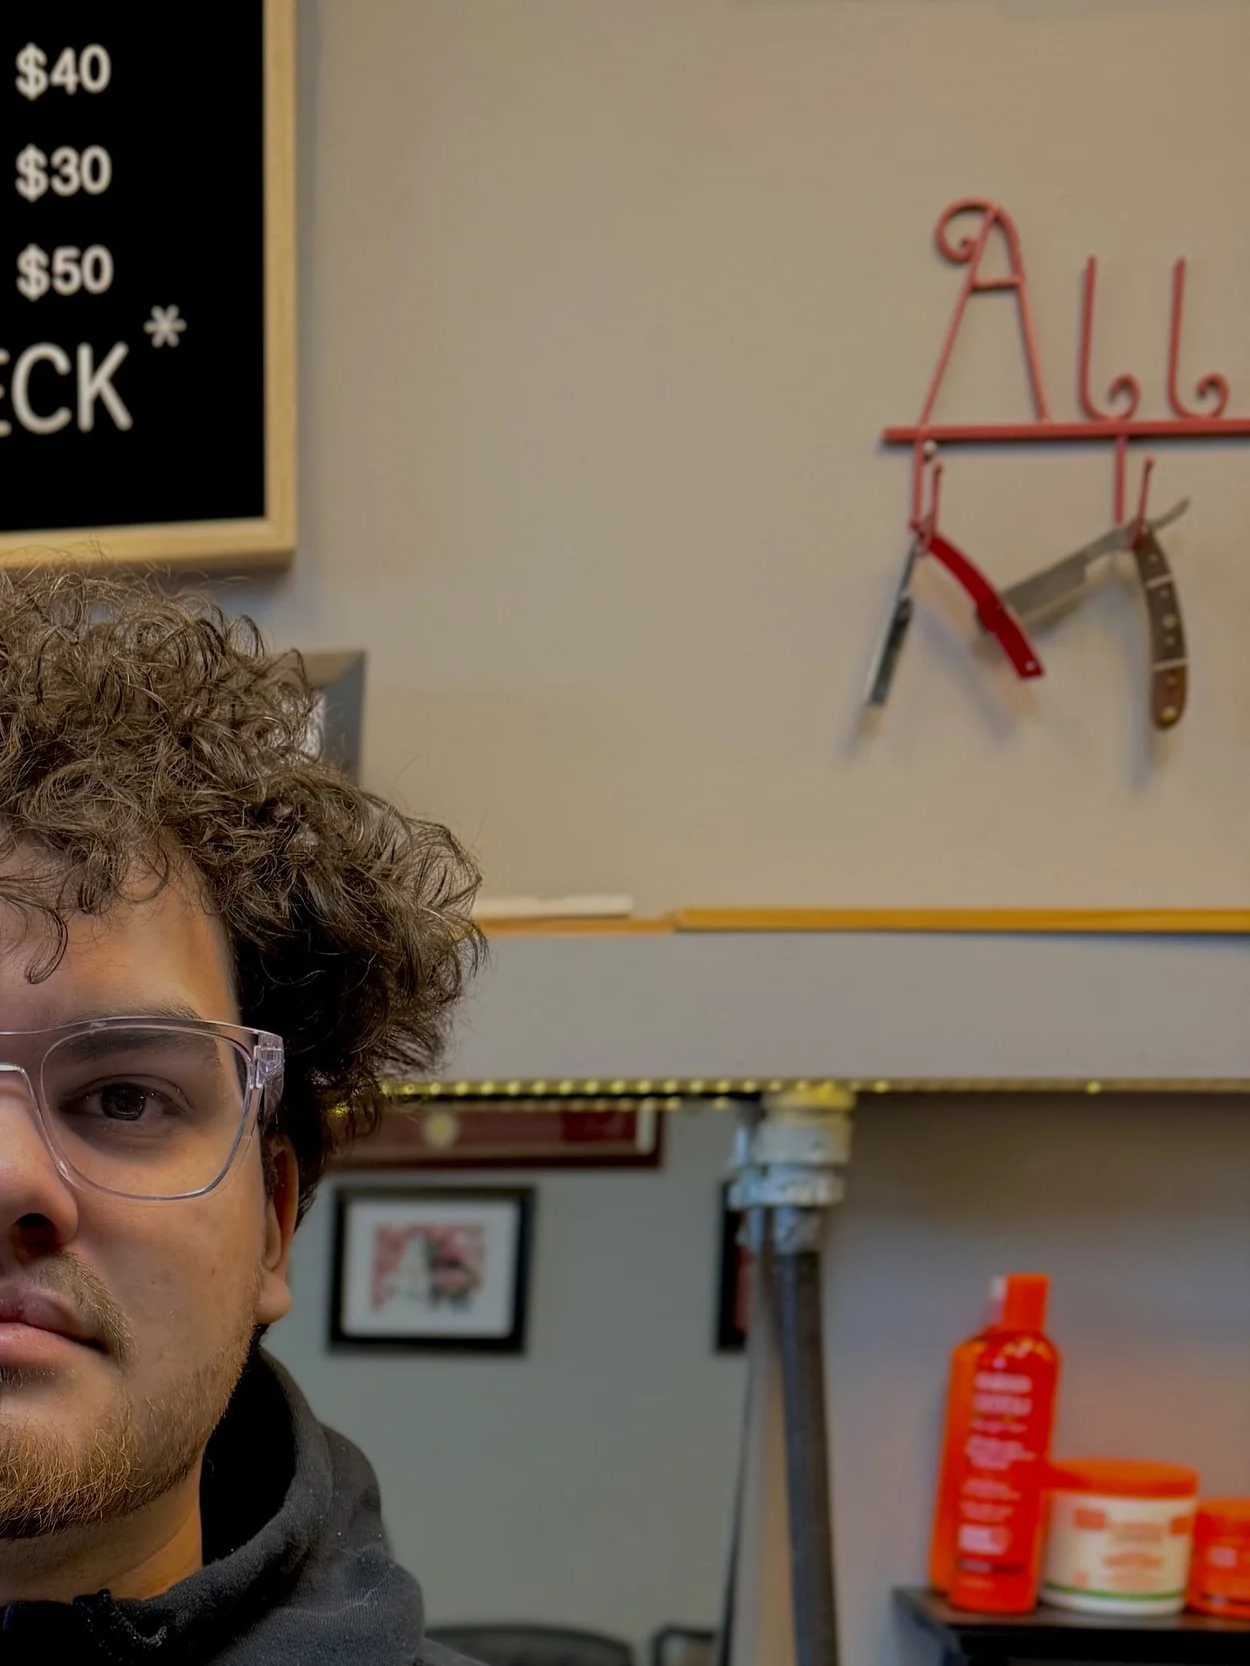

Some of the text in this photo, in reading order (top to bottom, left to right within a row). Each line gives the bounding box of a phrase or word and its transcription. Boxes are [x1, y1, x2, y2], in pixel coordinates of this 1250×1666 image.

[16, 44, 111, 100] $40
[16, 146, 112, 200] $30
[17, 245, 113, 300] $50
